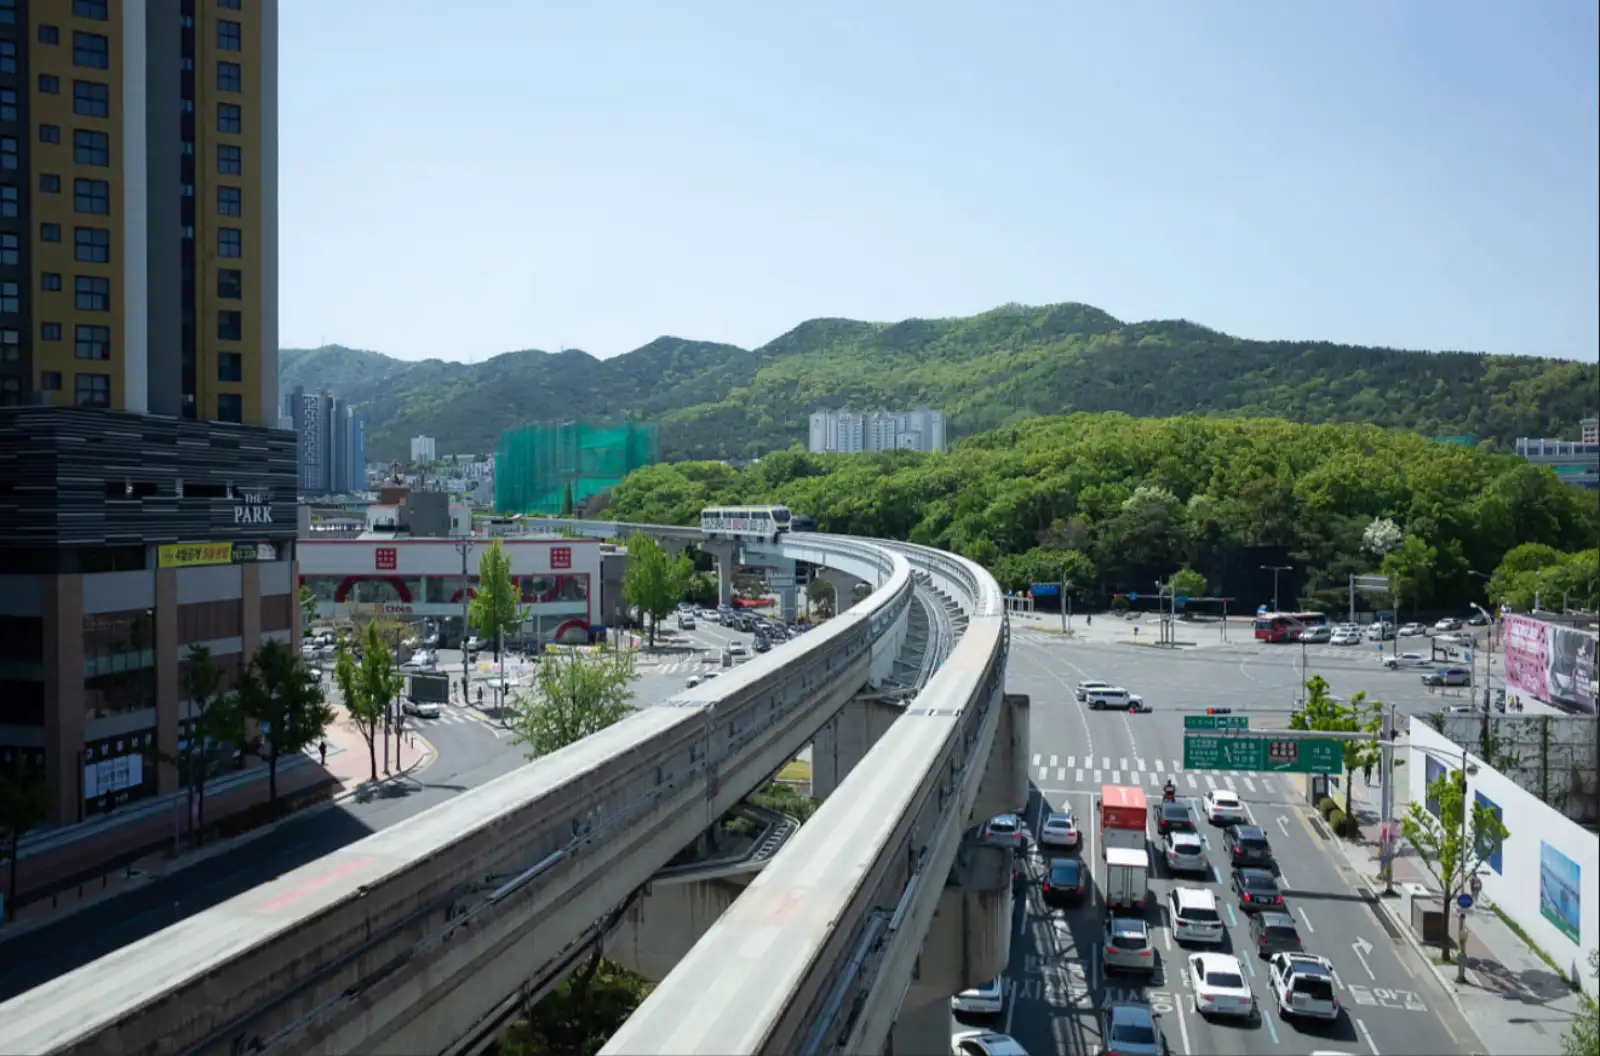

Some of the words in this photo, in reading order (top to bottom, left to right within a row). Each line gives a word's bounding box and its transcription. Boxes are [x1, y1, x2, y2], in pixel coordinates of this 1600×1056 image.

[245, 494, 262, 504] THE
[234, 506, 272, 523] PARK
[1347, 984, 1429, 1012] 들안길
